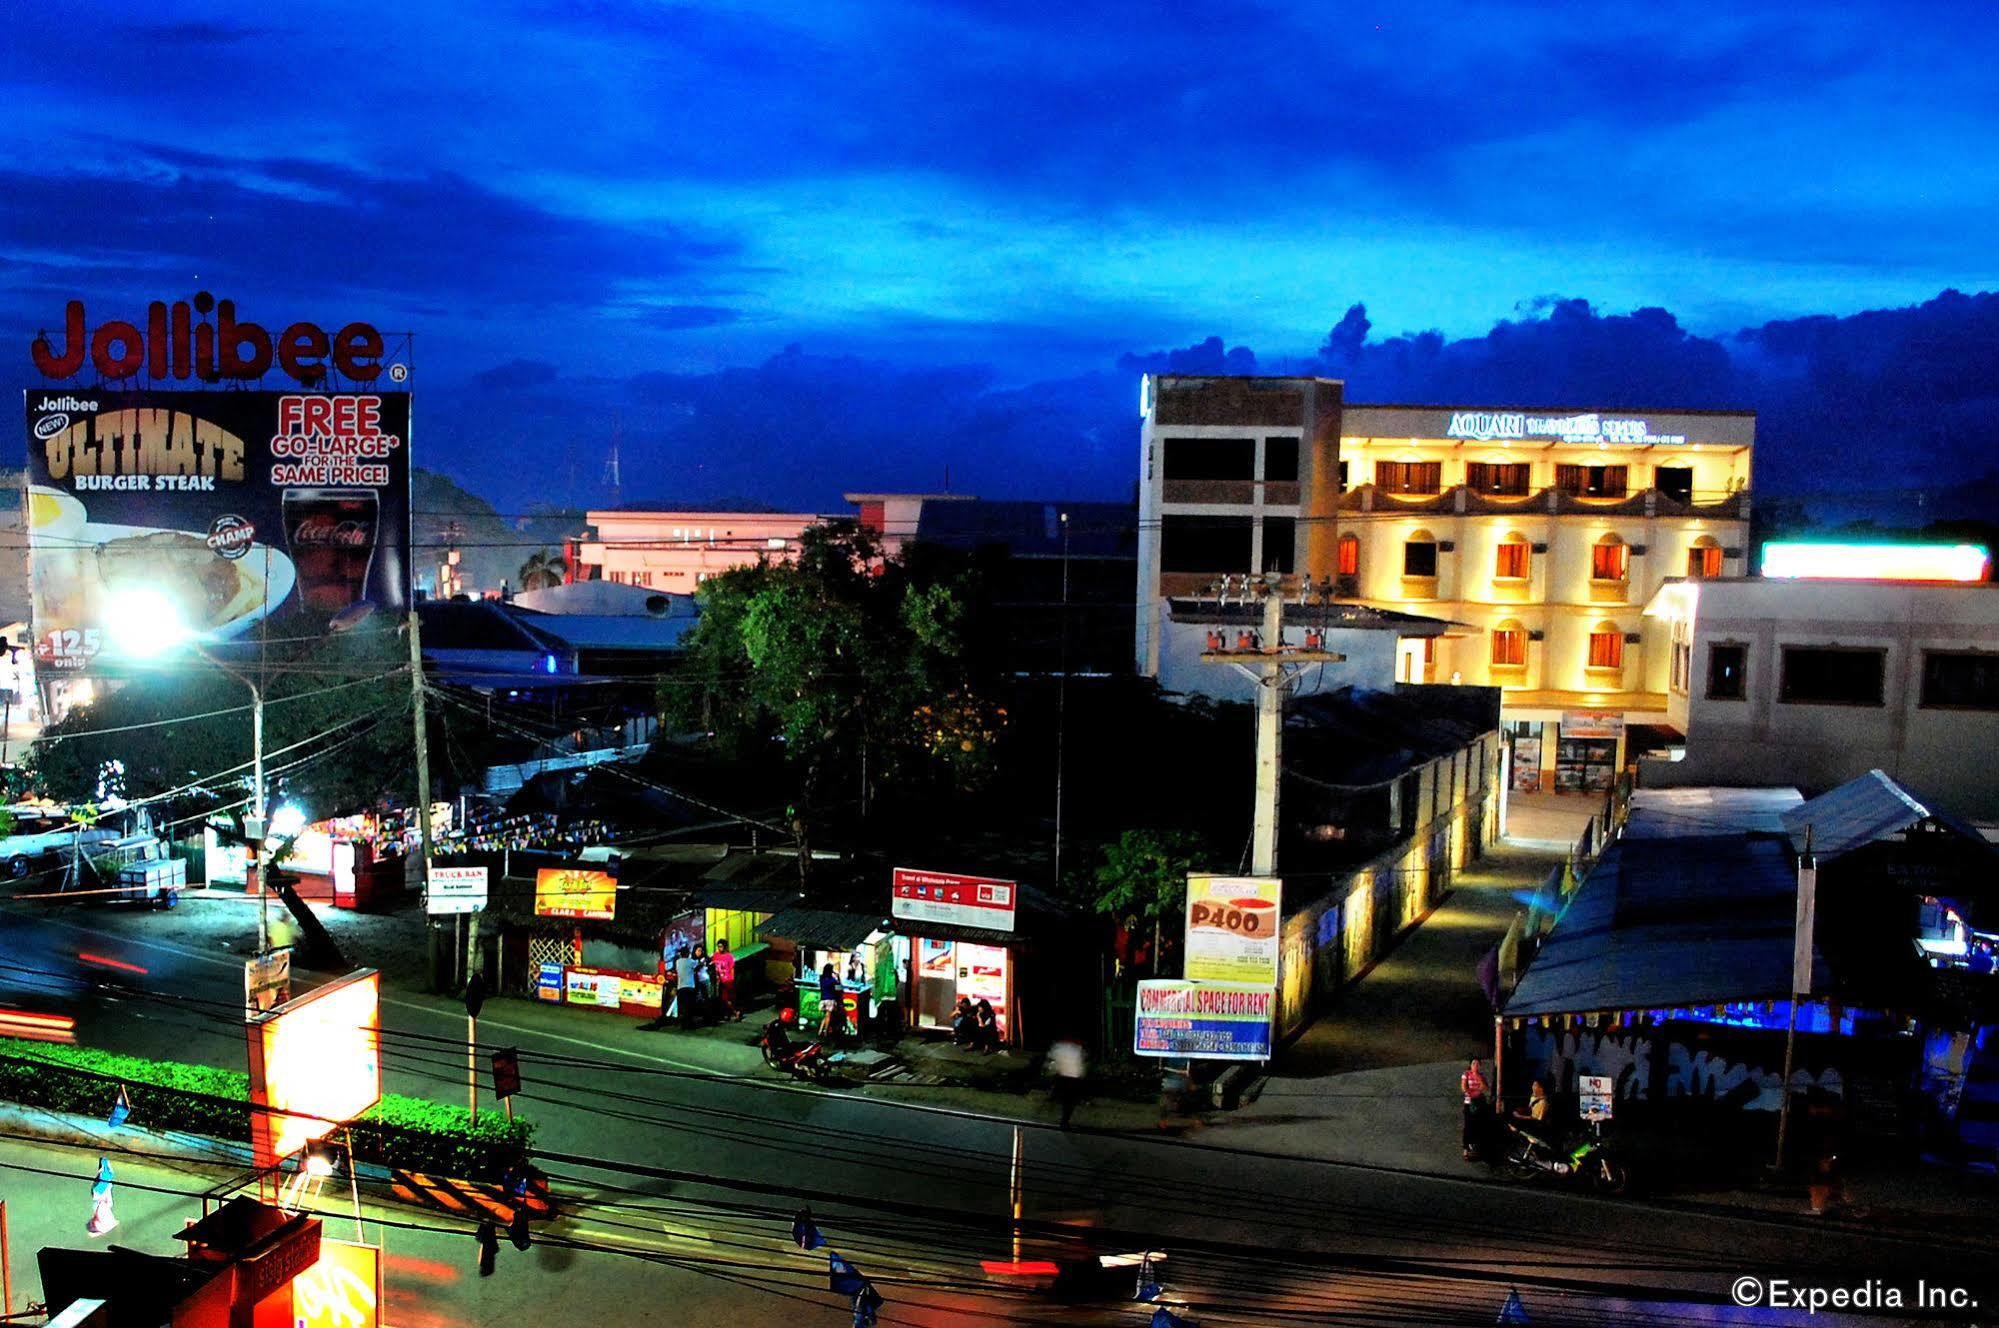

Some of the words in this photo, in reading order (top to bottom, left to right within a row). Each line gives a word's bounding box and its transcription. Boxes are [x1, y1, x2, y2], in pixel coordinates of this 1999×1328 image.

[32, 291, 384, 380] Jollibee
[38, 396, 98, 411] Jollibee
[39, 416, 65, 435] NEW!
[279, 396, 381, 437] FREE
[1447, 413, 1524, 440] AQUARI
[45, 408, 244, 480] ULTIMATE
[304, 456, 329, 466] FOR
[332, 456, 356, 466] THE
[75, 475, 150, 490] BURGER
[155, 475, 215, 491] STEAK
[272, 464, 327, 484] SAME
[330, 465, 389, 485] PRICE!
[207, 526, 255, 549] CHAMP
[54, 656, 86, 670] only
[1197, 990, 1226, 1015] SPACE
[1229, 991, 1245, 1016] FOR
[1247, 992, 1270, 1016] RENT
